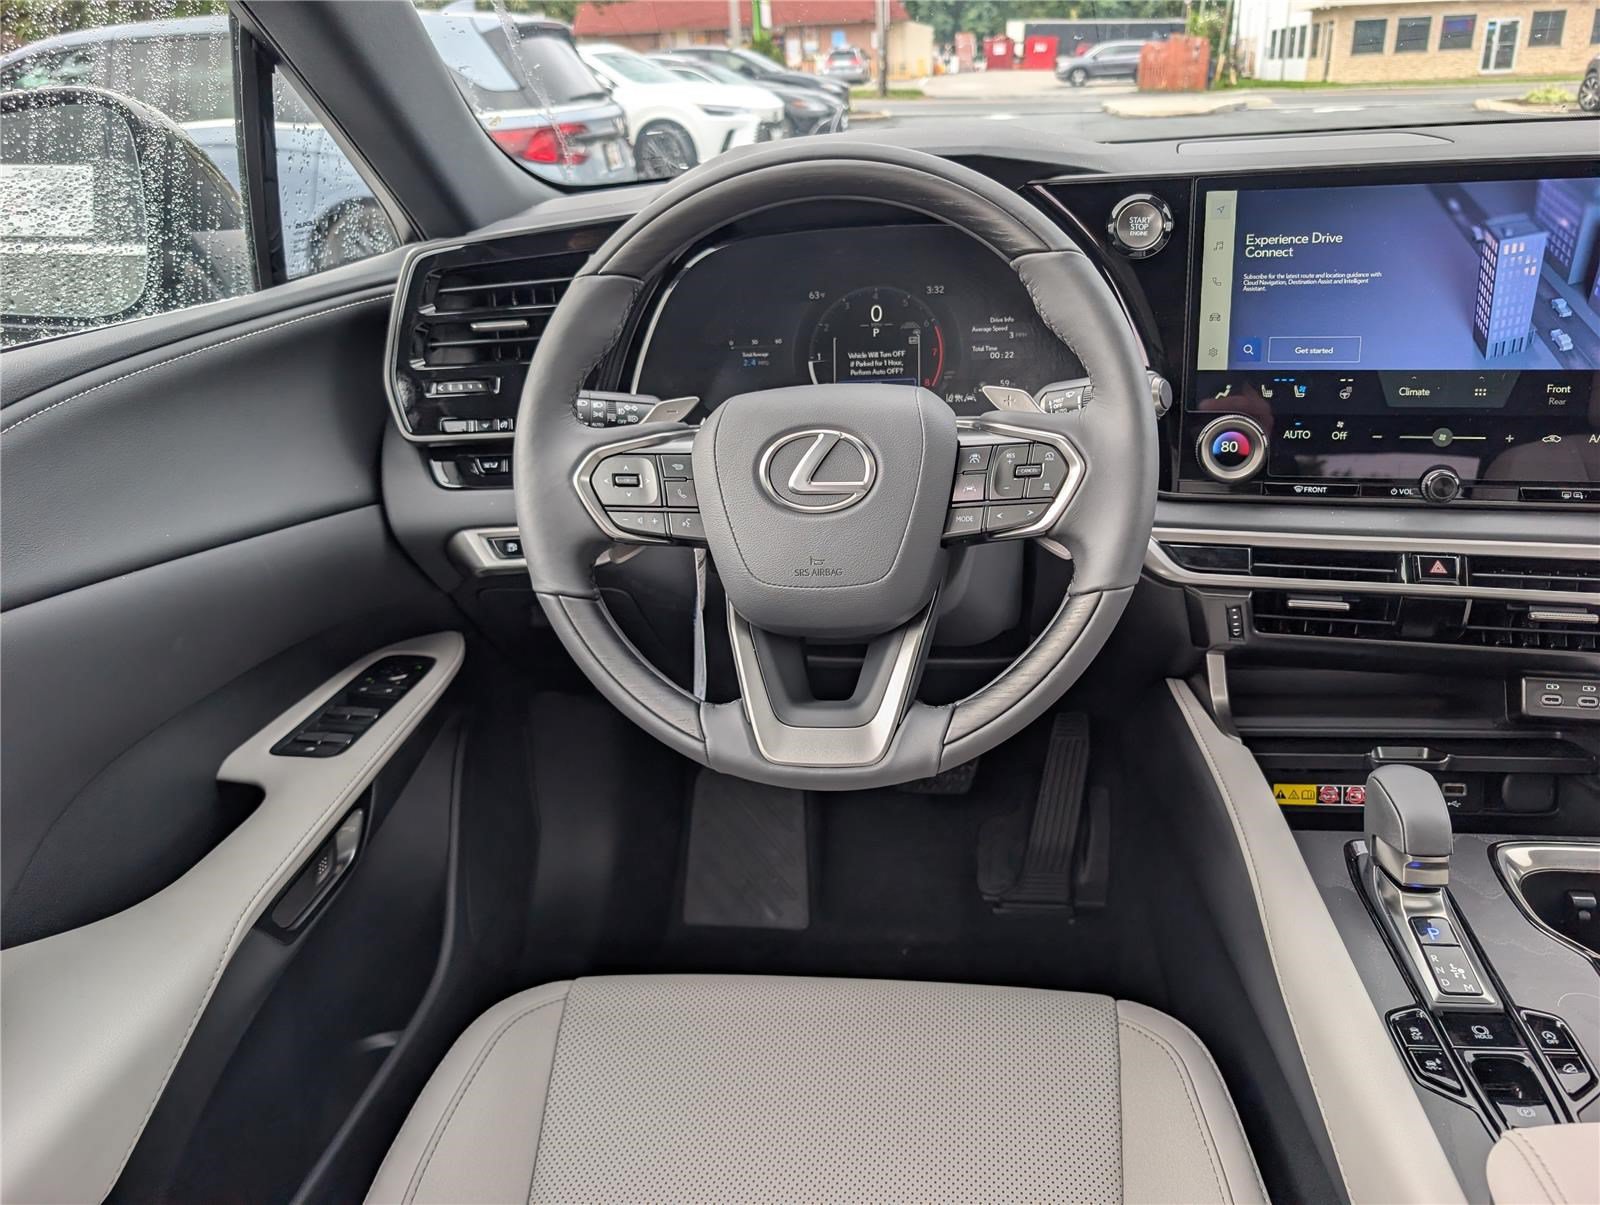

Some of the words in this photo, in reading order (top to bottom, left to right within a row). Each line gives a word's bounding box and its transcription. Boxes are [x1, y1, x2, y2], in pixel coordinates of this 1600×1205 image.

[1129, 216, 1151, 224] START
[1246, 233, 1309, 247] Experience
[1312, 232, 1343, 244] Drive
[1246, 247, 1294, 258] Connect
[926, 285, 945, 294] 3:32
[870, 304, 883, 322] 0
[873, 328, 880, 338] P
[1295, 346, 1309, 354] Get
[1310, 346, 1333, 354] started
[1398, 387, 1430, 396] Climate
[1547, 384, 1571, 394] Front
[1283, 430, 1311, 439] AUTO
[1332, 431, 1348, 440] Off
[1220, 441, 1238, 453] 80
[812, 568, 843, 576] AIRBAG
[1427, 928, 1439, 940] P
